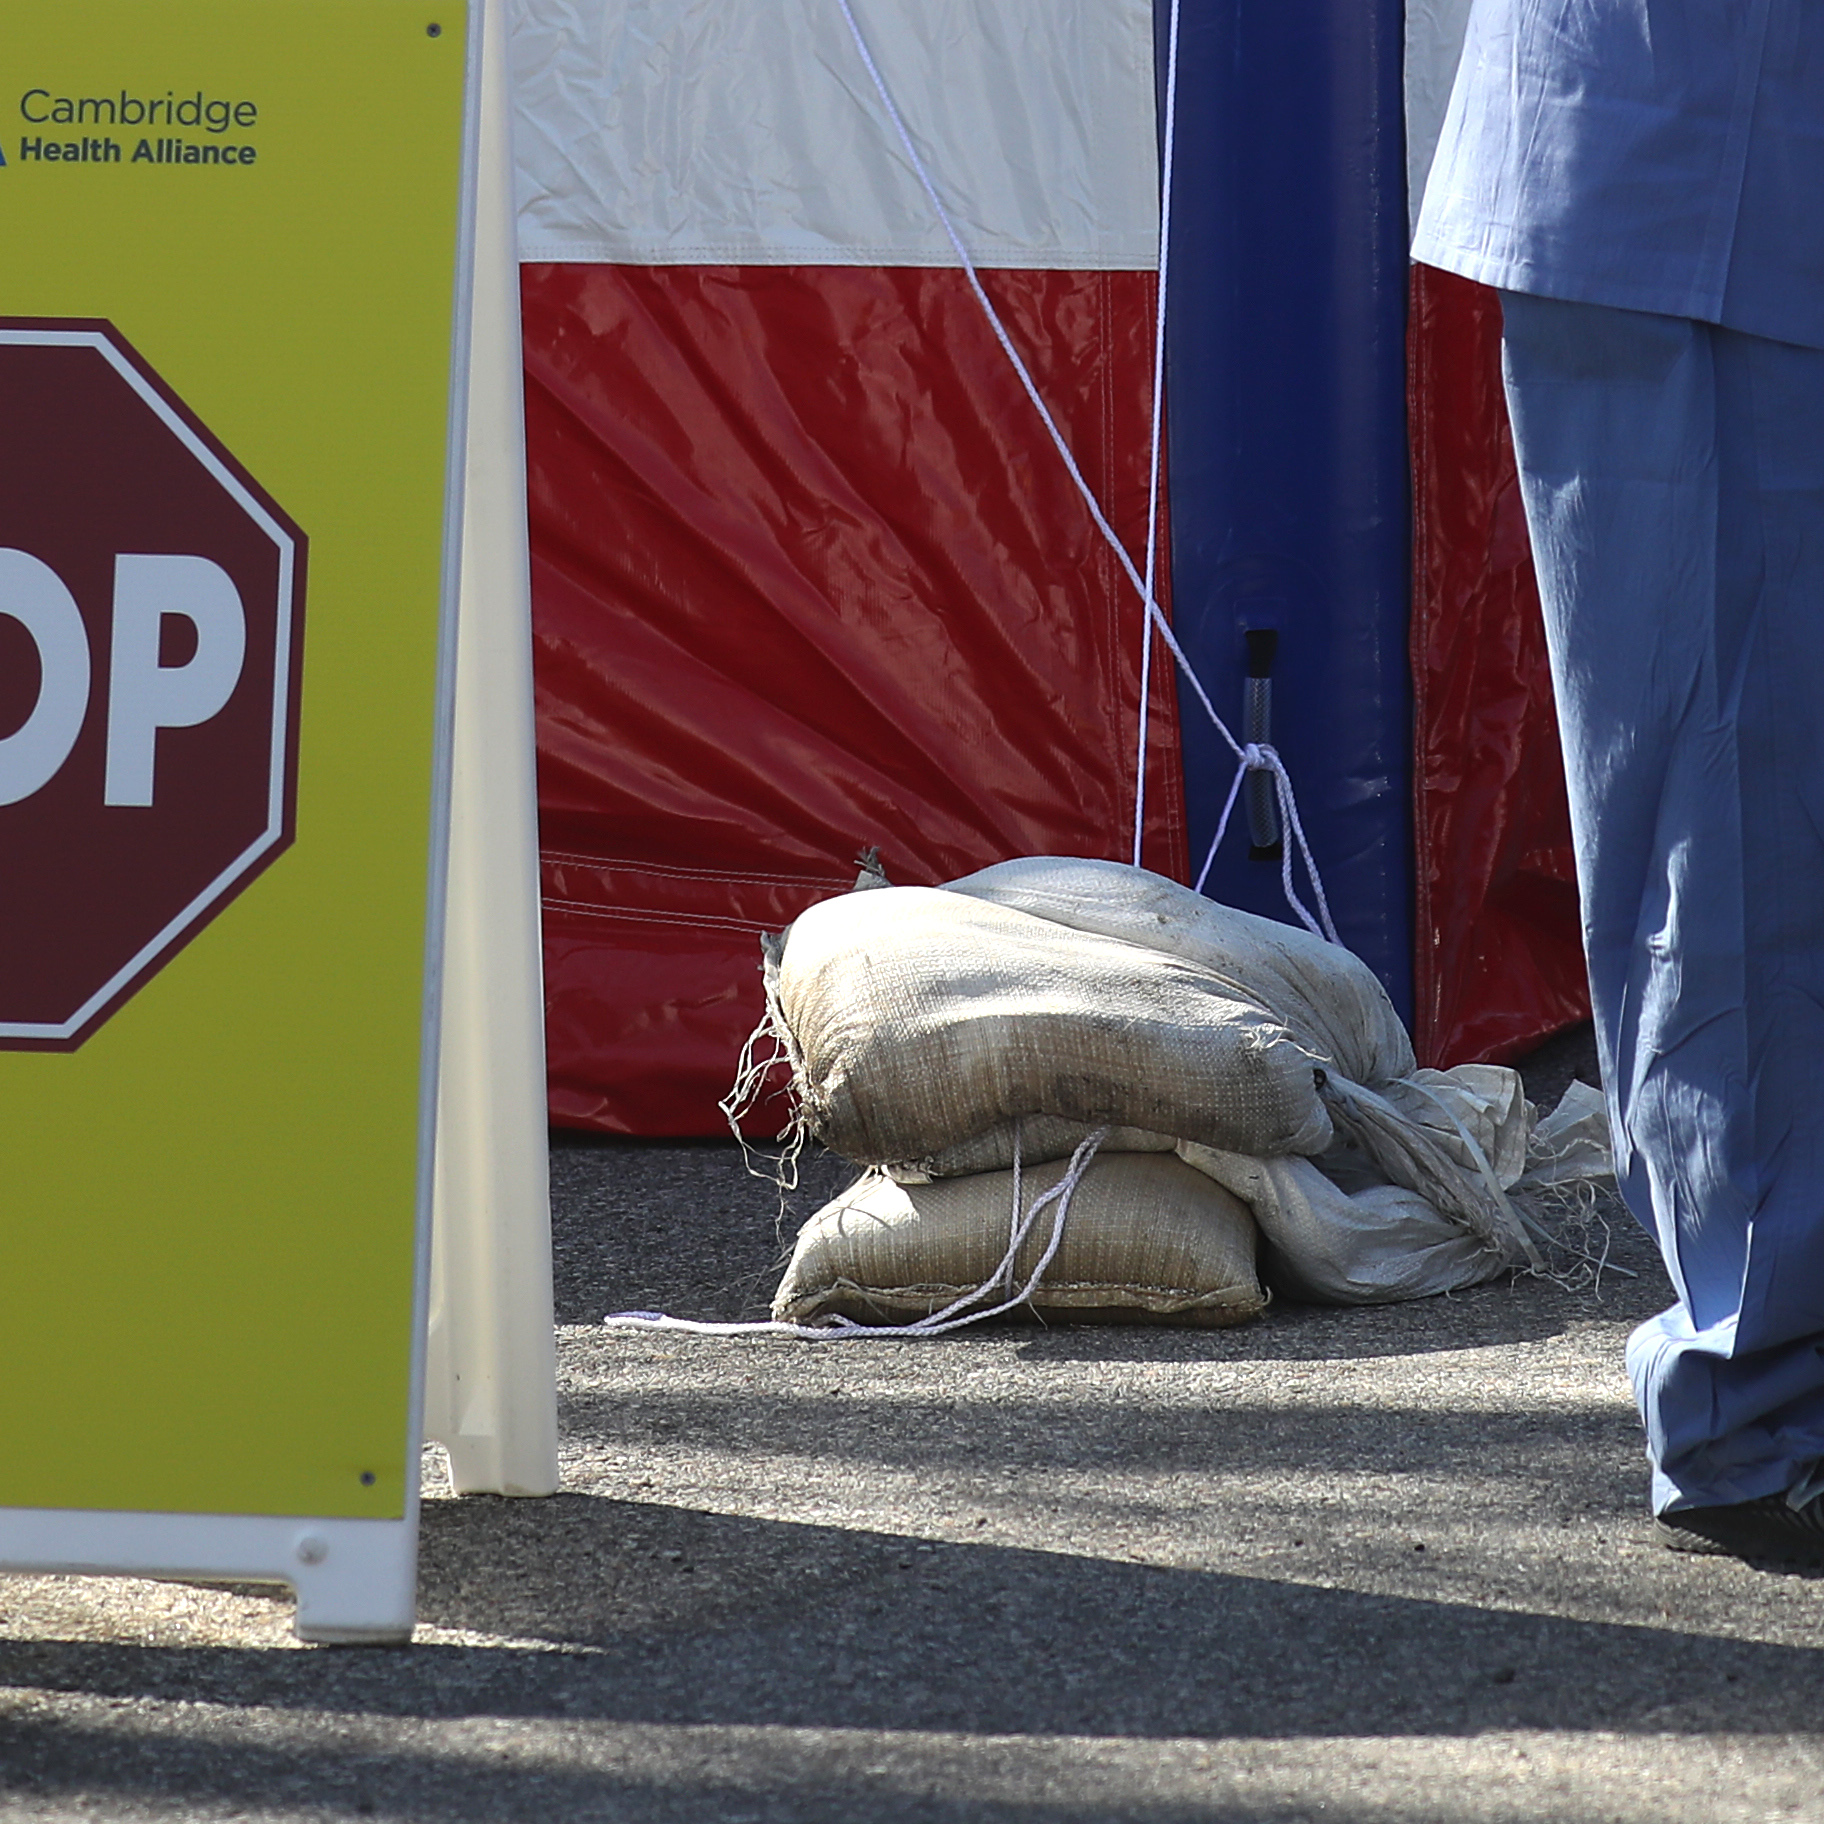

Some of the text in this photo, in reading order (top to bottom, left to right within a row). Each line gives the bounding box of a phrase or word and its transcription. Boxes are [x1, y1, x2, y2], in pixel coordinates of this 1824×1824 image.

[20, 88, 258, 133] Cambridge
[20, 137, 257, 165] Health Alliance
